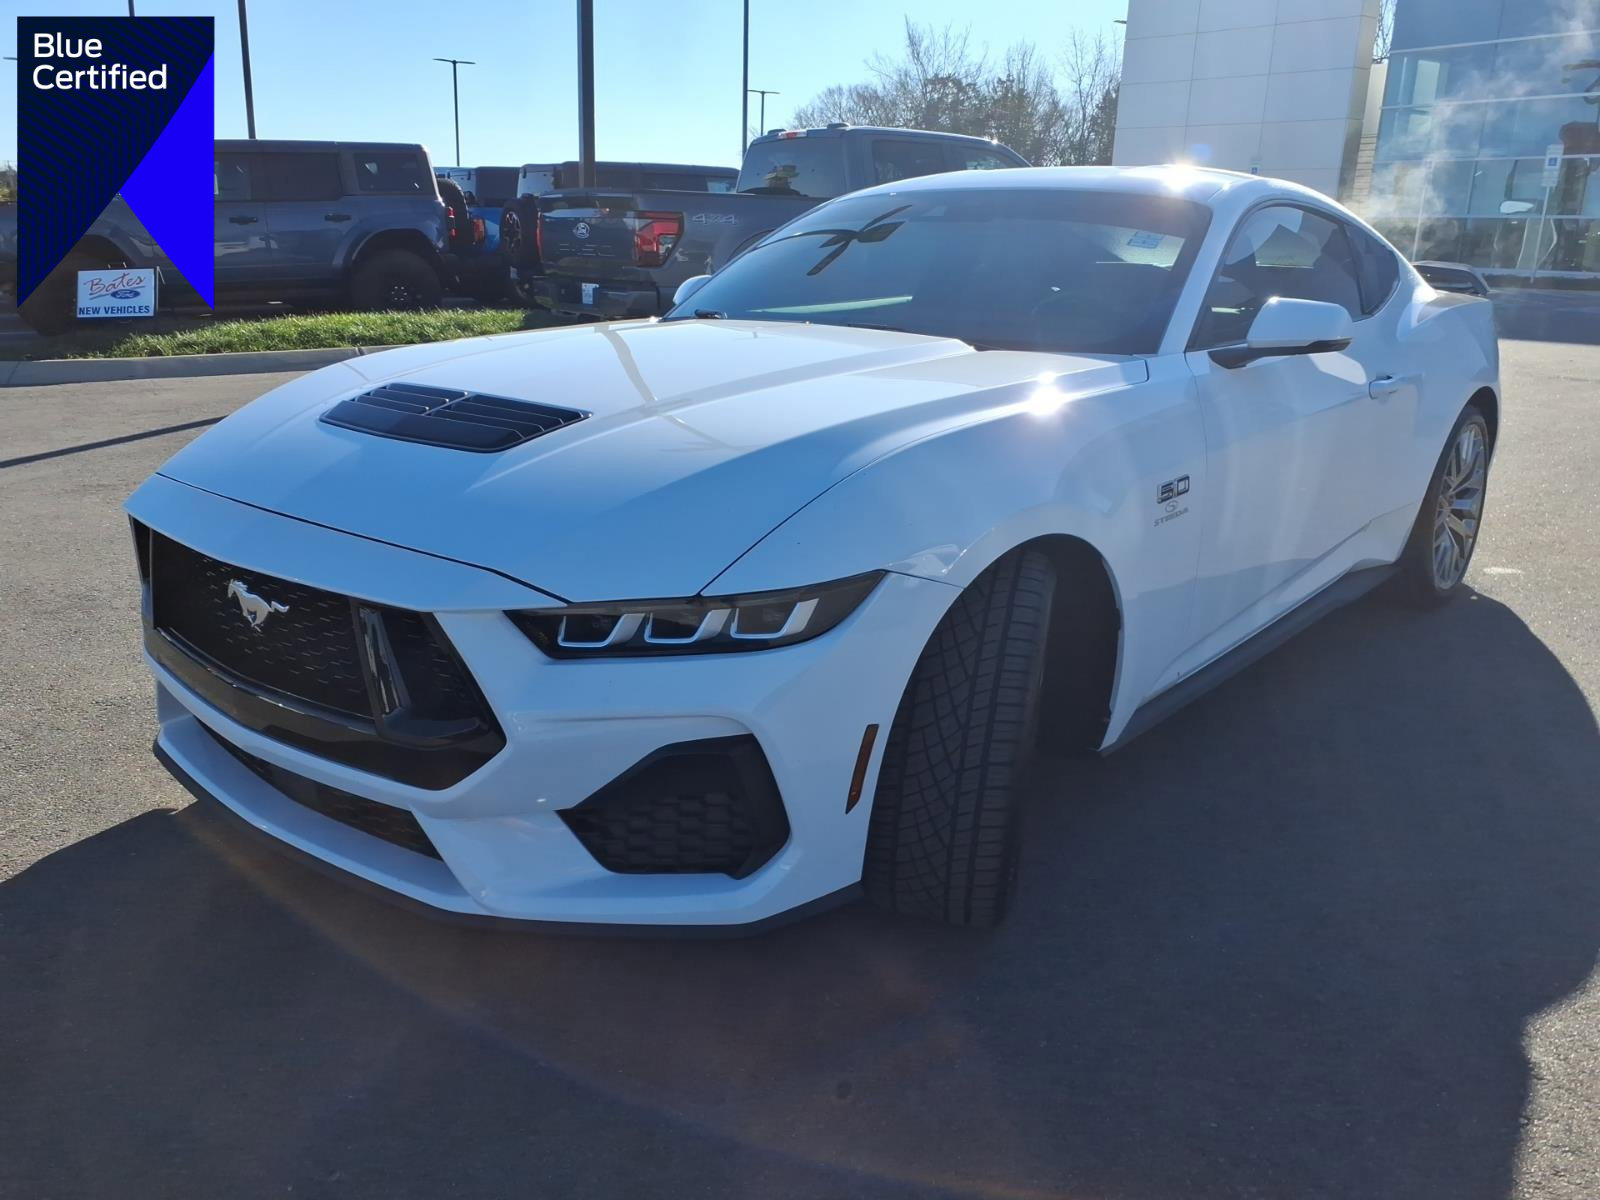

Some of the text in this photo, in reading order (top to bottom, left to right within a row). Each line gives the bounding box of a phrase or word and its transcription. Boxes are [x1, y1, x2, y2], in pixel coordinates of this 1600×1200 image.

[83, 272, 146, 295] Bates
[78, 305, 150, 315] NEW VEHICLES
